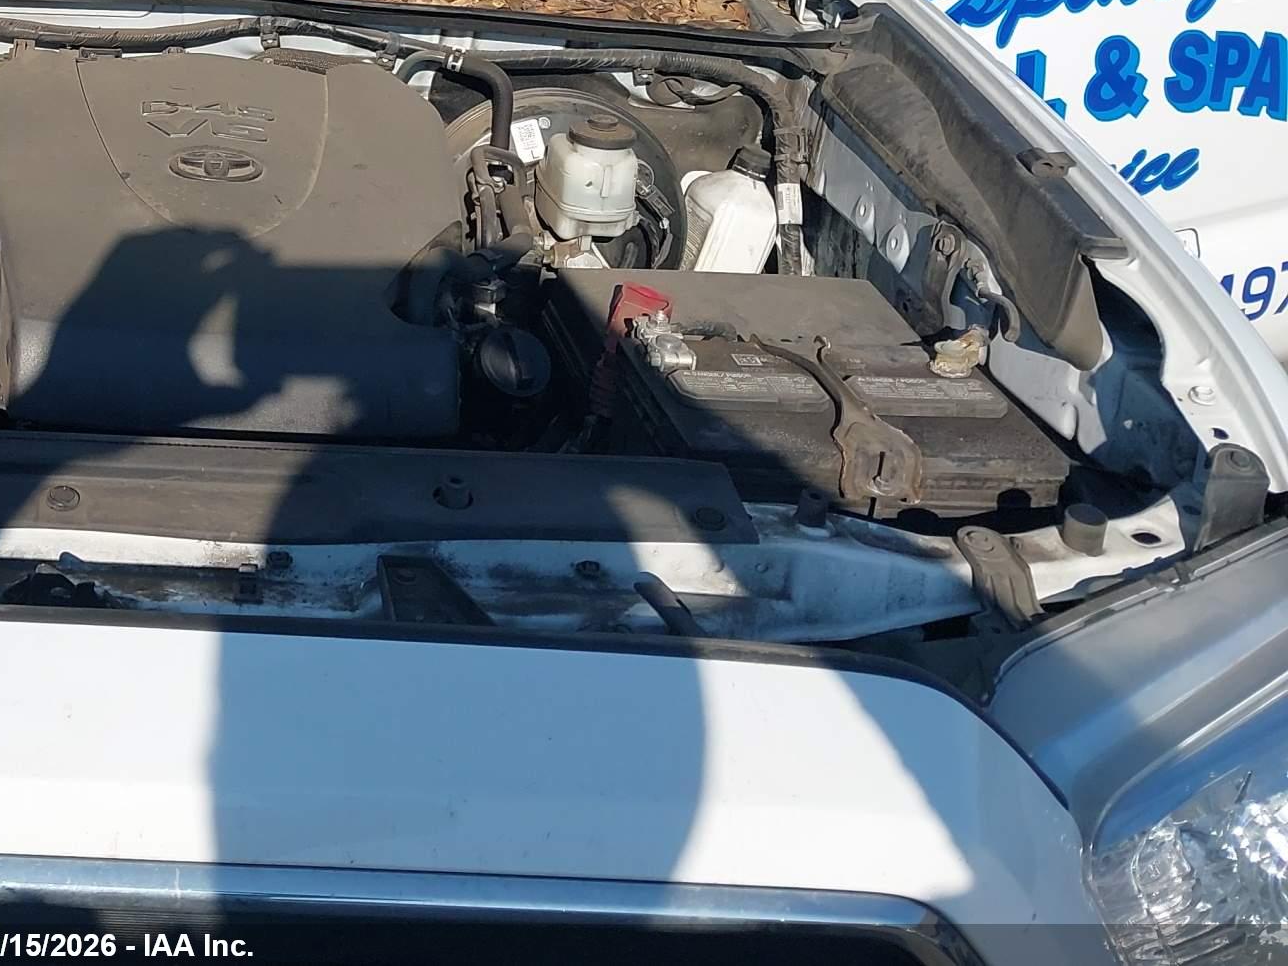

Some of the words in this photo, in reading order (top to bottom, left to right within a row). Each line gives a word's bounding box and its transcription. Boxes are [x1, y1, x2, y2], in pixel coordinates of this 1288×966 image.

[1083, 34, 1149, 122] &
[1164, 29, 1288, 122] SPA
[145, 118, 269, 143] V6
